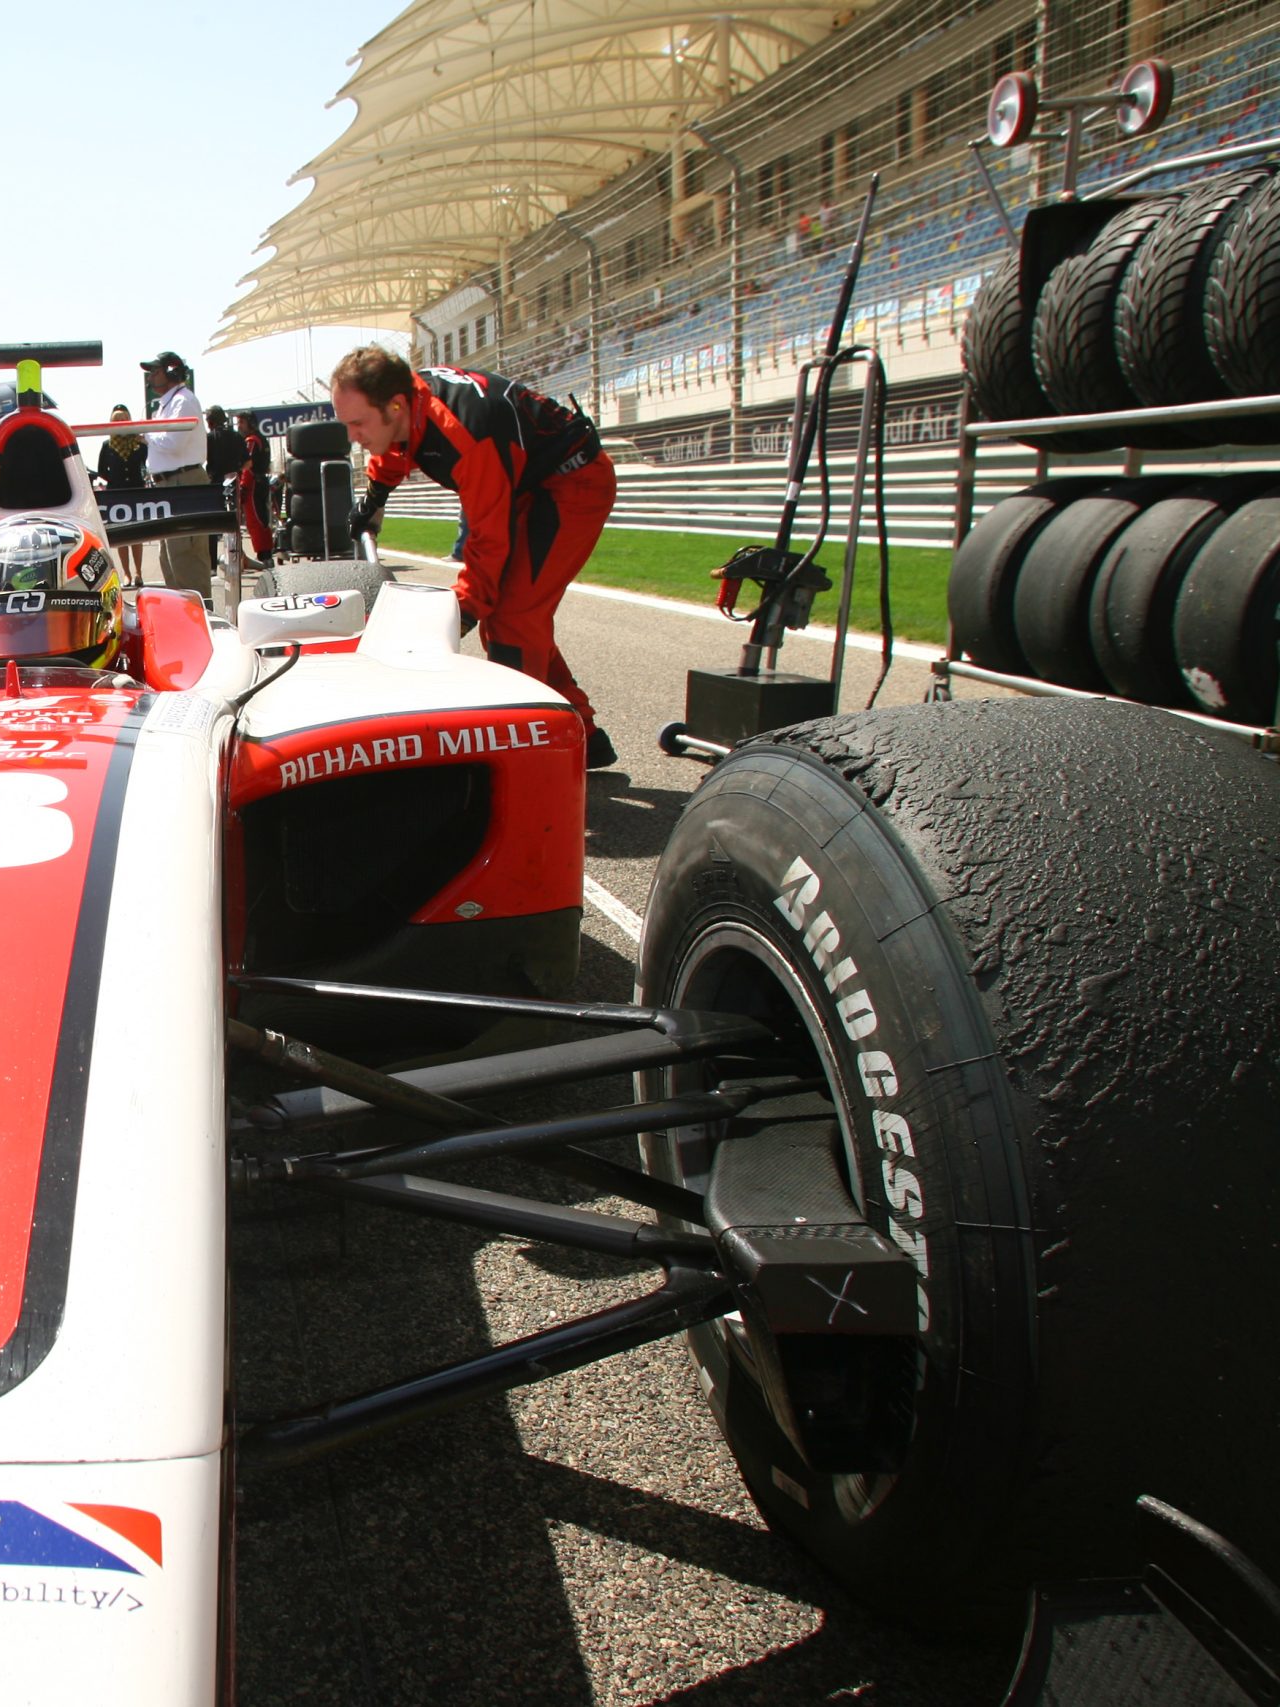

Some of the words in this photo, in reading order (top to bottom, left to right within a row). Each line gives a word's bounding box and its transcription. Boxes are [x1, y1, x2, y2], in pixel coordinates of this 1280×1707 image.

[51, 598, 100, 607] motorsport
[261, 593, 312, 612] elf
[279, 734, 423, 789] RICHARD
[439, 720, 550, 757] MILLE
